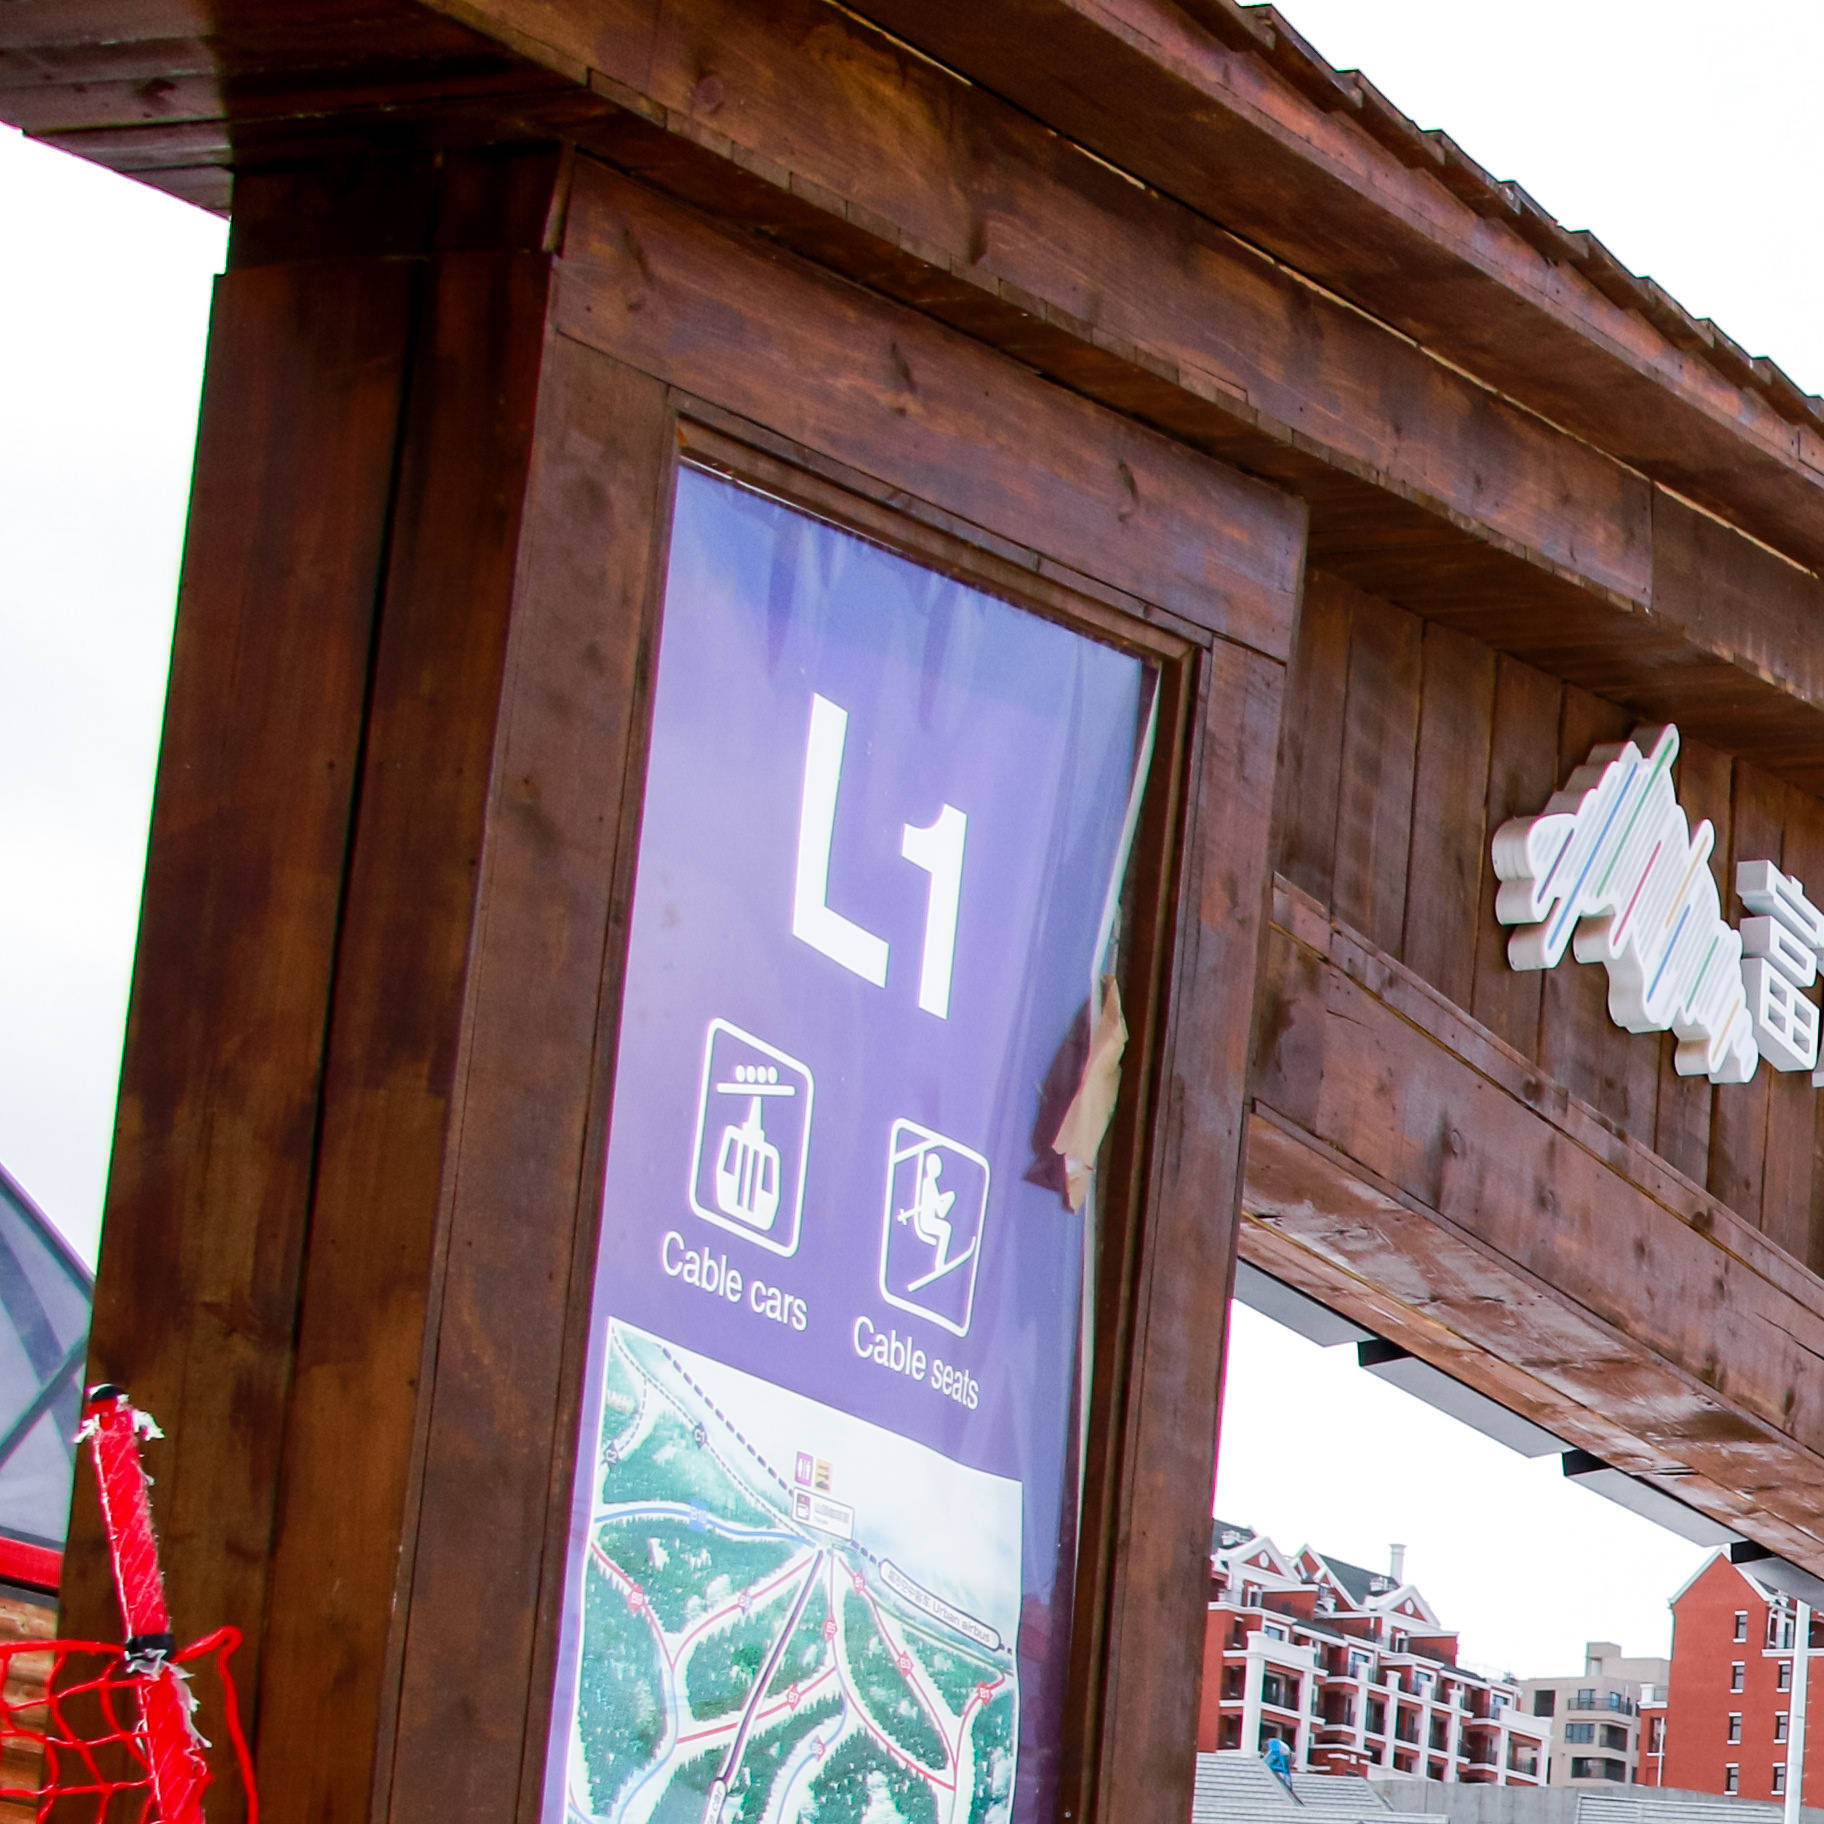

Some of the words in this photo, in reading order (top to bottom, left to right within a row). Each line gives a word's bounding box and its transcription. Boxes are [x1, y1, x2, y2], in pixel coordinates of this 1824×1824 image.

[791, 692, 968, 1020] L1
[660, 1232, 745, 1304] Cable
[749, 1281, 809, 1334] cars
[851, 1312, 927, 1385] Cable
[929, 1357, 981, 1413] seats
